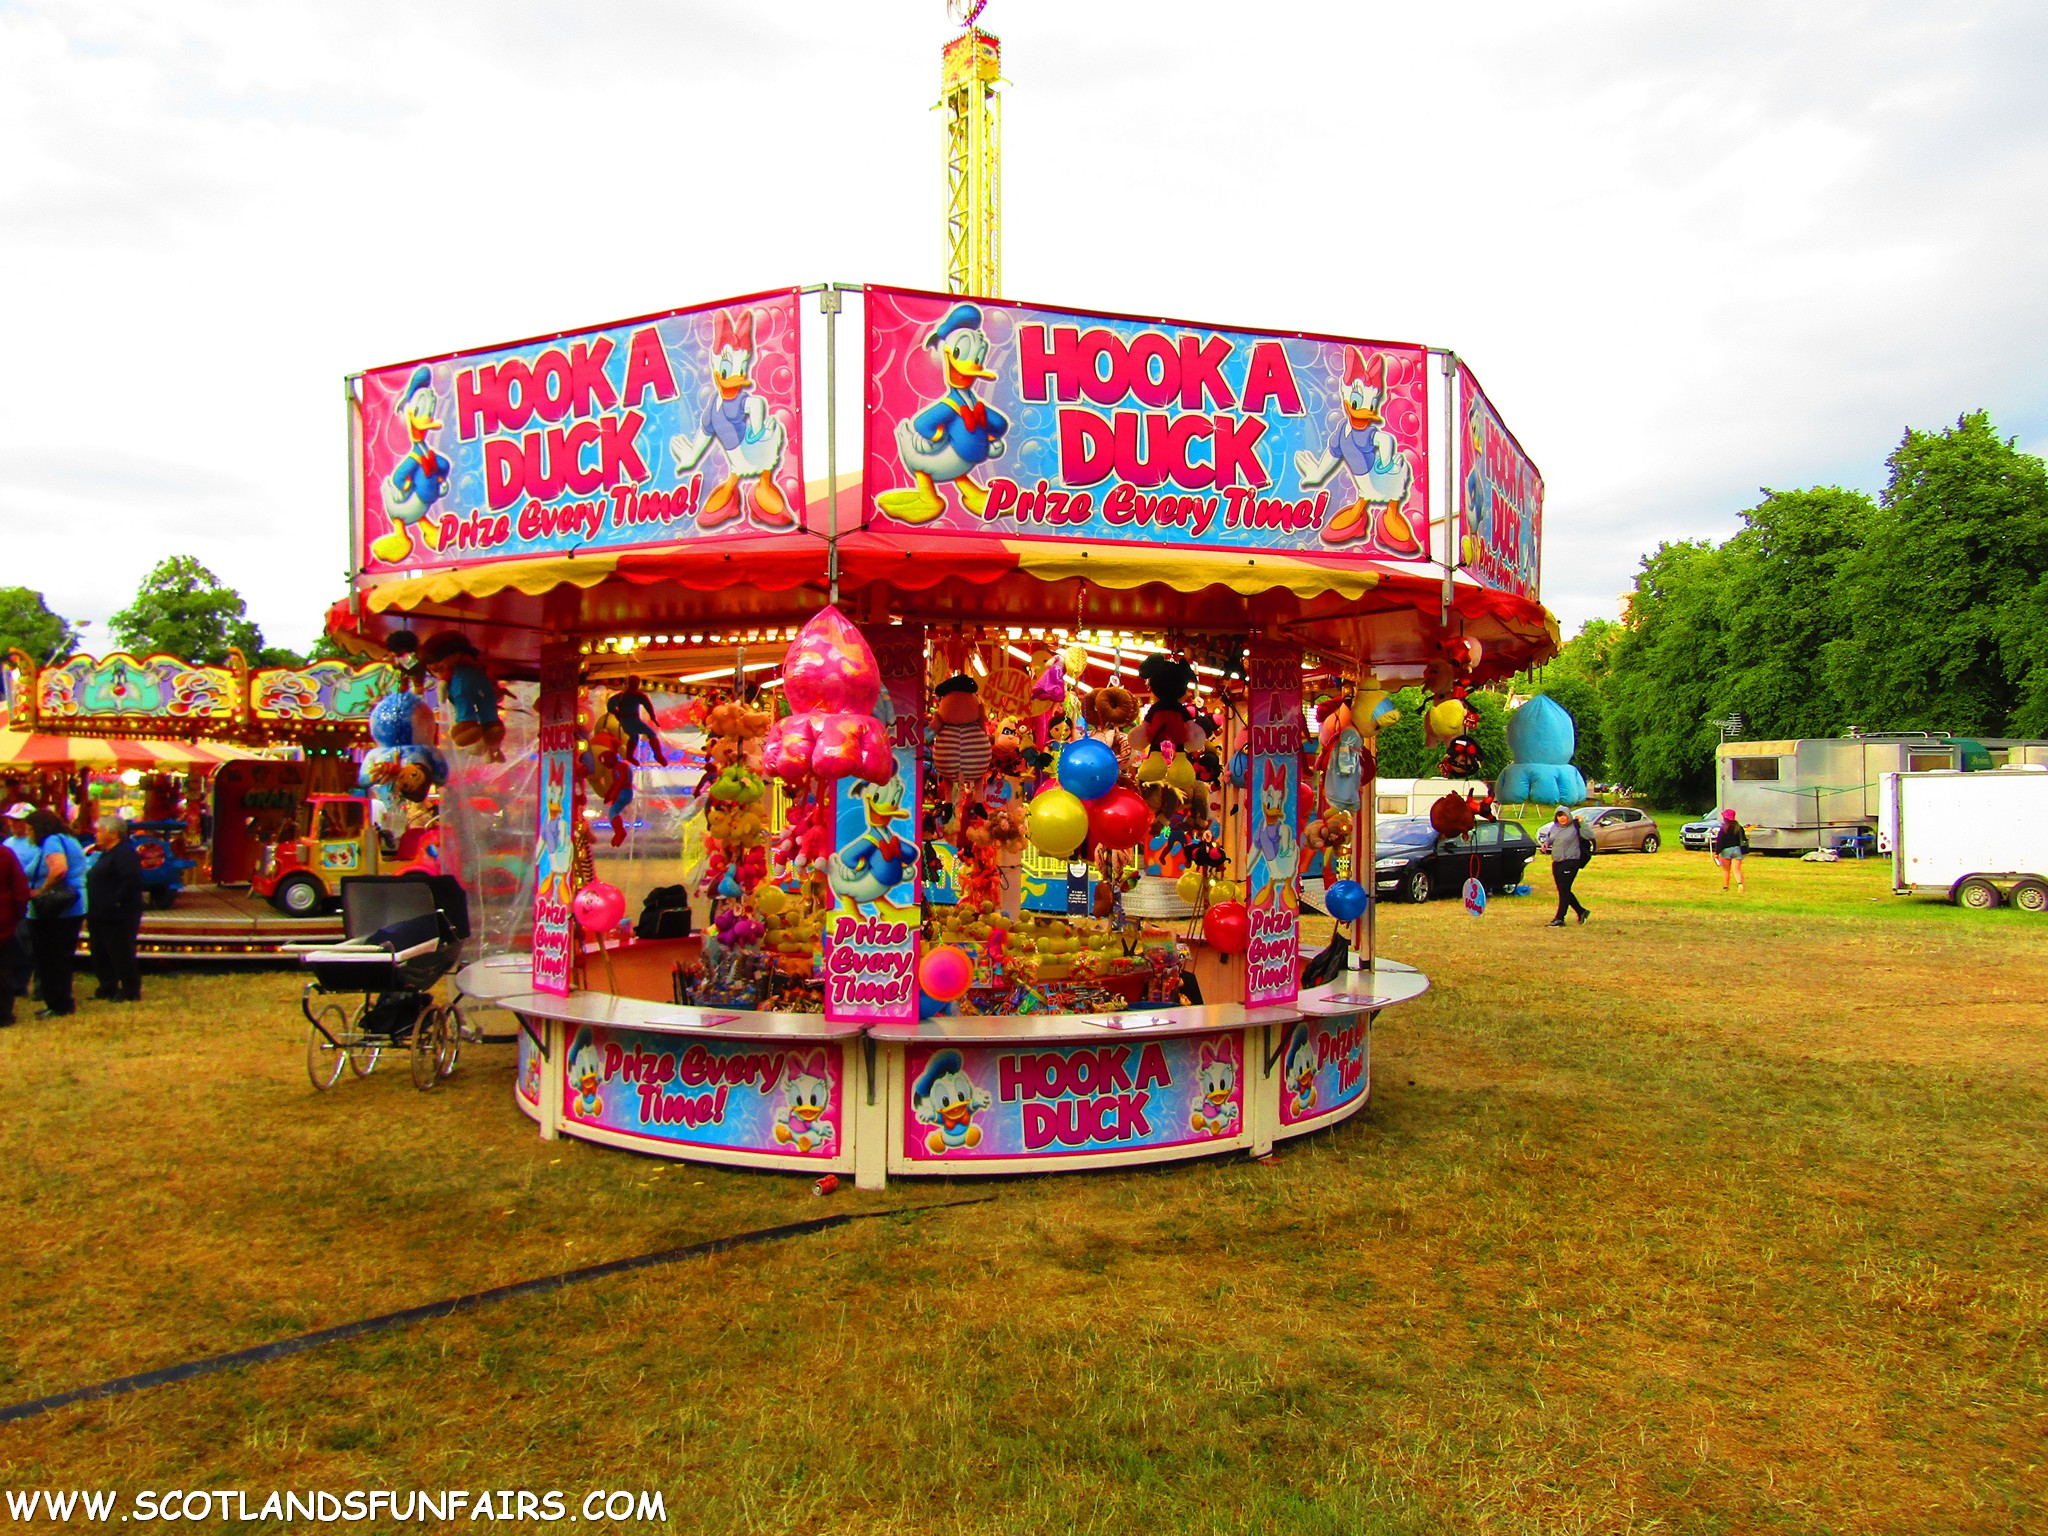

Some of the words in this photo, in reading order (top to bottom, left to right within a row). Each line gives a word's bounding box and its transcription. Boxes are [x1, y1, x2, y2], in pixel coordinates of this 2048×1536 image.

[457, 337, 618, 441] HOOK
[621, 327, 680, 407] A
[1020, 324, 1238, 409] HOOK
[1241, 341, 1304, 414] A
[485, 411, 651, 511] DUCK
[1059, 407, 1272, 491] DUCK
[437, 511, 508, 552] Prize
[518, 497, 606, 540] Every
[611, 475, 703, 527] Time!
[984, 479, 1091, 525] Prize
[1103, 481, 1218, 536] Every
[1223, 488, 1329, 533] Time!
[876, 642, 917, 677] OK
[1250, 658, 1299, 690] HOOK
[1268, 691, 1284, 723] A
[542, 722, 575, 755] DUCK
[1252, 723, 1300, 757] DUCK
[536, 897, 568, 925] Prize
[1249, 906, 1293, 938] Prize
[833, 915, 909, 946] Prize
[828, 945, 914, 979] Every
[1247, 935, 1296, 965] Every
[829, 973, 914, 1006] Time!
[1248, 956, 1295, 992] Time!
[604, 1042, 677, 1085] Prize
[680, 1045, 786, 1093] Every
[998, 1046, 1135, 1102] HOOK
[1134, 1042, 1172, 1091] A
[636, 1084, 729, 1128] Time!
[1021, 1090, 1152, 1151] DUCK
